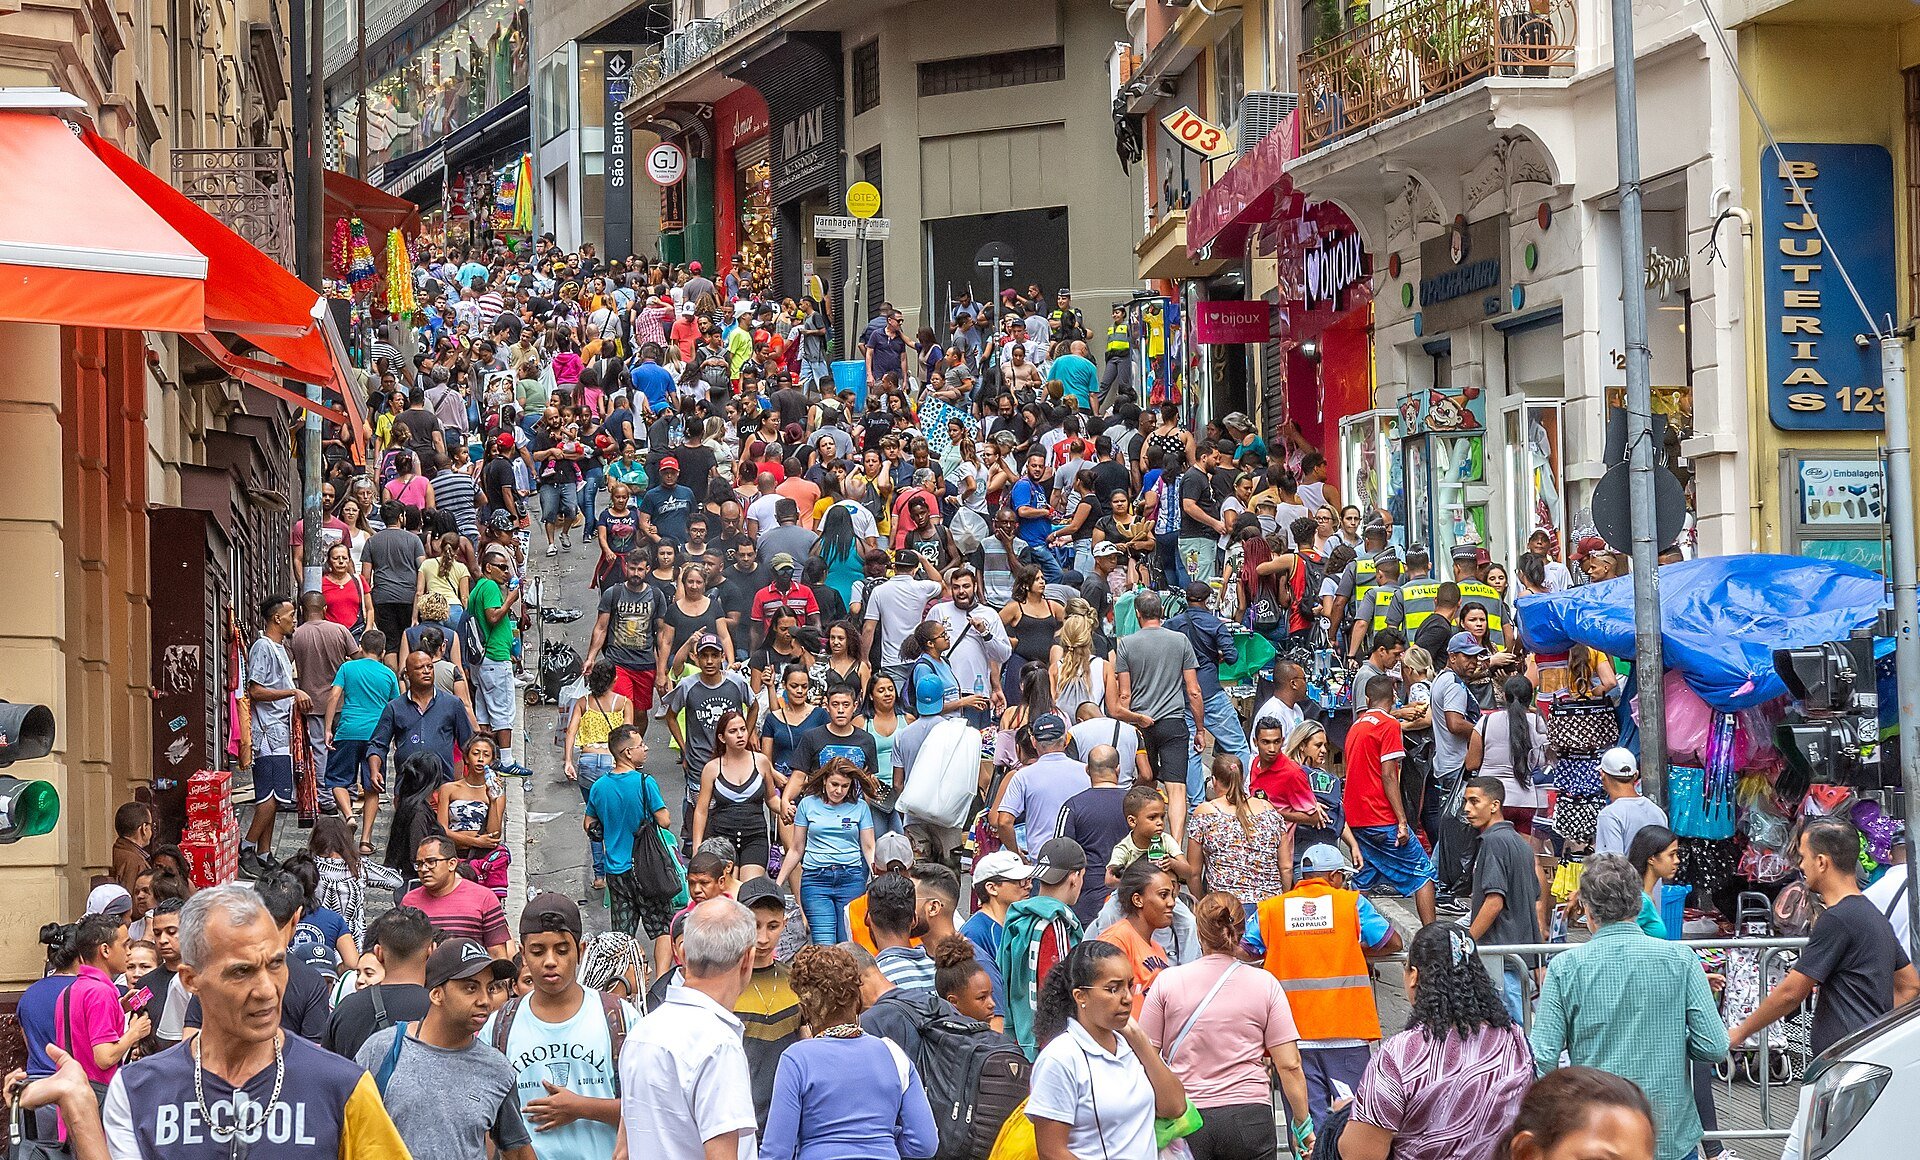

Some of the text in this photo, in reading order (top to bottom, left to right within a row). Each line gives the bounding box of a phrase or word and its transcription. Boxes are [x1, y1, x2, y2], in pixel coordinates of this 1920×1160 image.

[696, 103, 714, 119] 73
[781, 105, 823, 162] MAXI
[1171, 110, 1221, 151] 103
[609, 111, 624, 187] São Bento
[653, 151, 678, 169] GJ
[848, 193, 878, 201] LOTEX
[815, 217, 857, 229] Varnhagen
[1320, 229, 1363, 313] bijoux
[1778, 160, 1829, 412] BIJUTERIAS
[1221, 312, 1260, 327] bijoux
[1833, 469, 1885, 479] Embalagens
[619, 602, 649, 613] BEER
[512, 1043, 605, 1074] TROPICAL
